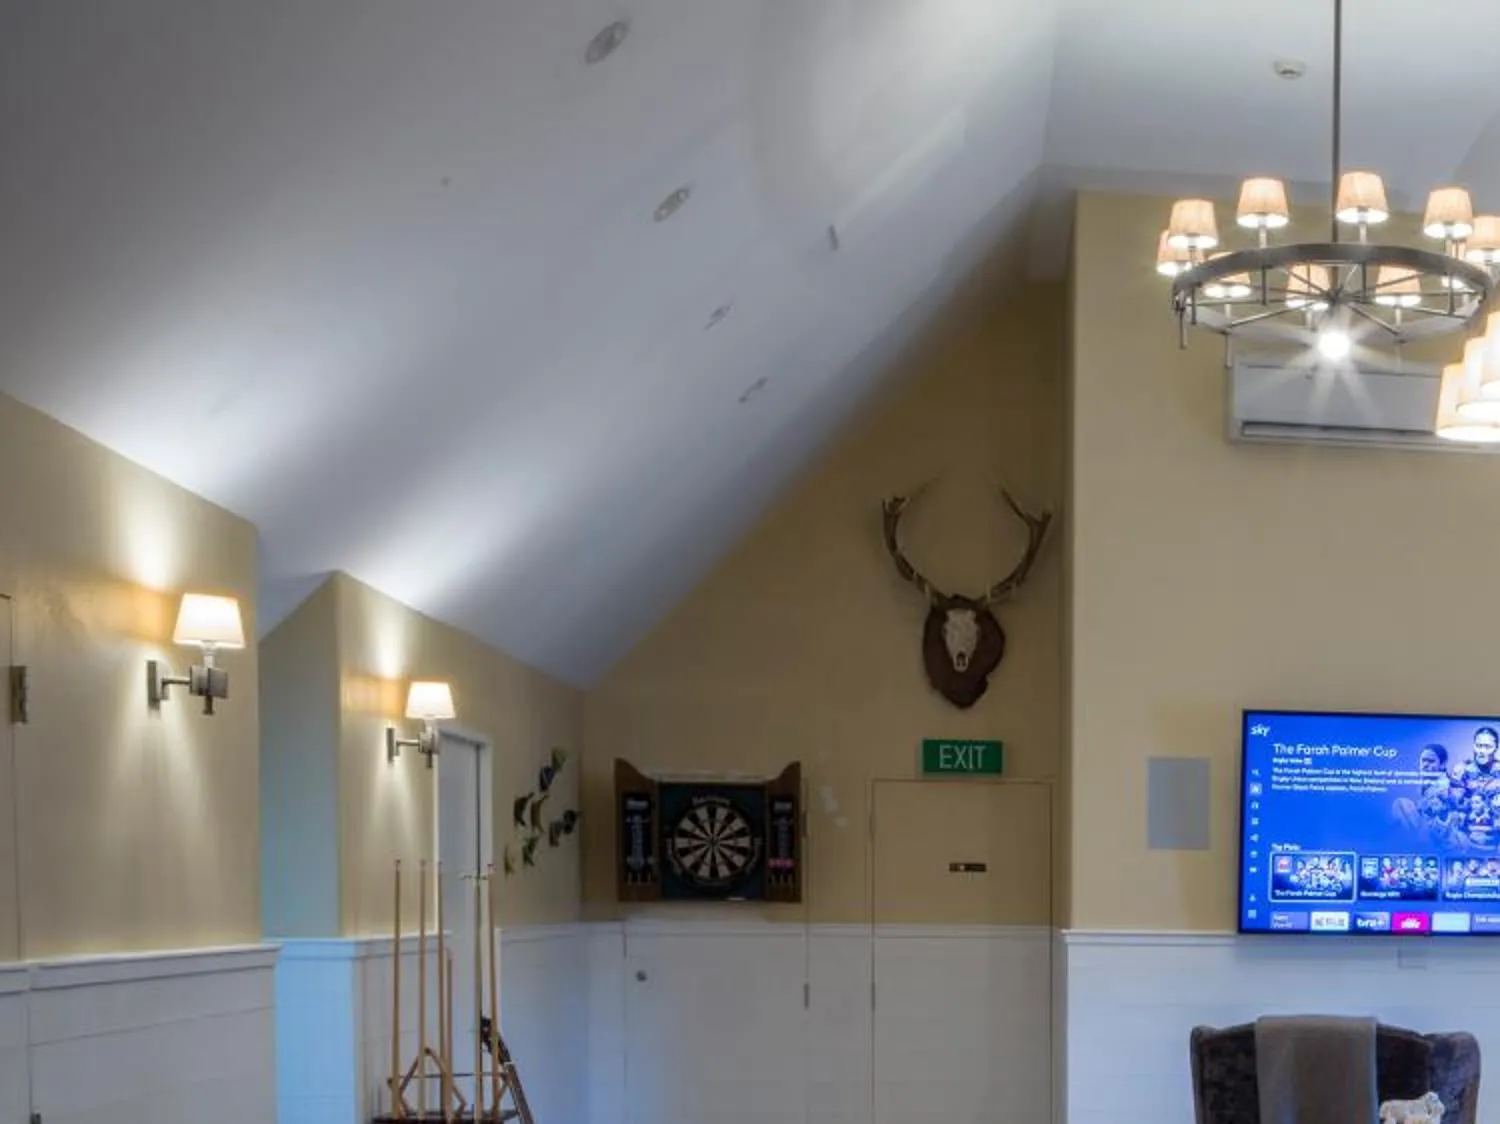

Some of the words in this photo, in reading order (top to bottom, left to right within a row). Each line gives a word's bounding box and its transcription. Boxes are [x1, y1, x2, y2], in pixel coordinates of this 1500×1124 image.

[1250, 723, 1270, 736] sky
[940, 744, 987, 769] EXIT
[1273, 743, 1294, 755] The
[1296, 743, 1329, 756] Farah
[1331, 744, 1369, 757] Palmer
[1373, 745, 1398, 758] Cup
